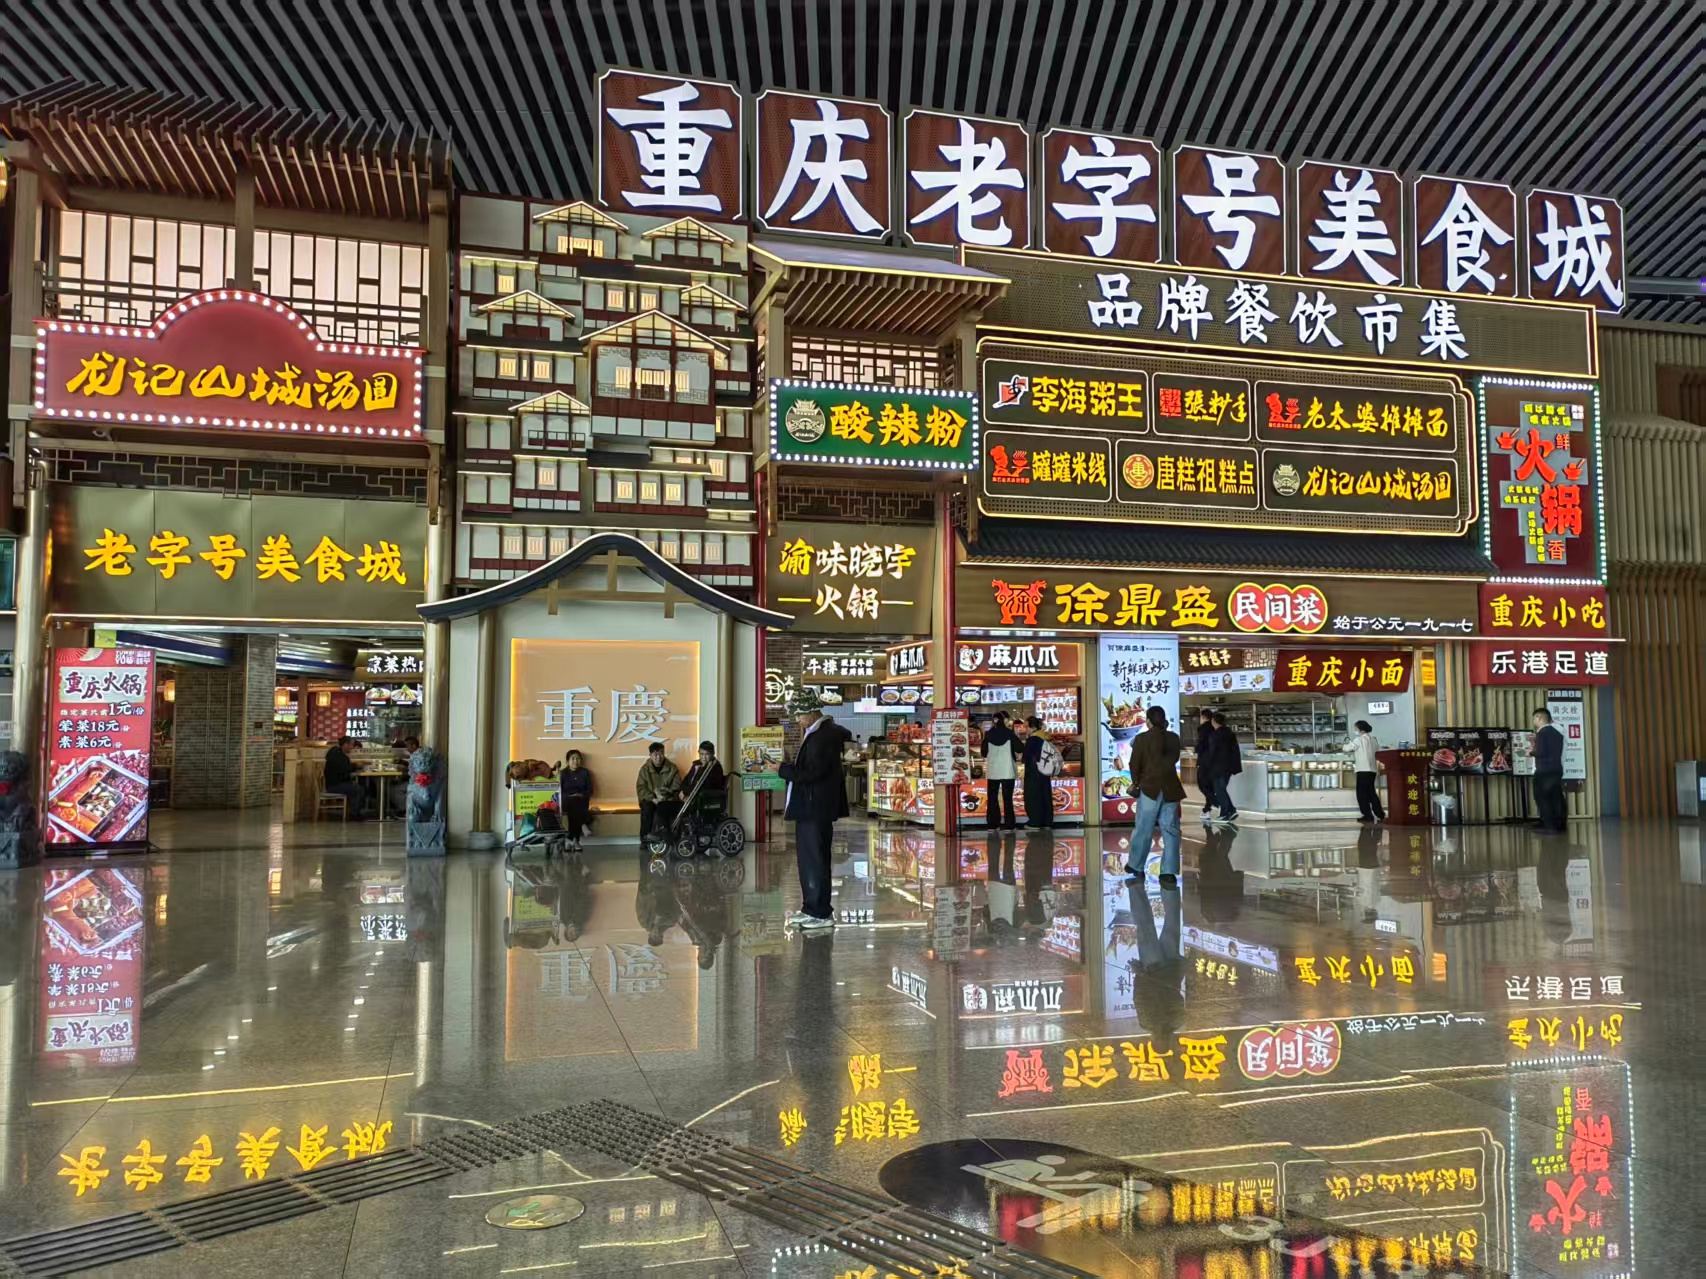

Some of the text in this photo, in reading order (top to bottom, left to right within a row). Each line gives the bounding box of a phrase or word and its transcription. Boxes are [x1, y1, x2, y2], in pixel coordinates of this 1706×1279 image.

[606, 81, 1625, 308] 重庆老字号美食城
[1088, 271, 1470, 361] 品牌餐饮市集
[65, 351, 399, 412] 龙记山城汤圆
[1031, 376, 1143, 418] 李海粥王
[829, 400, 968, 448] 酸辣粉
[1555, 432, 1570, 450] 鲜
[1031, 450, 1107, 487] 罐罐米线
[1156, 455, 1256, 495] 唐糕祖糕点
[1303, 465, 1451, 502] 龙记山城汤圆
[84, 528, 407, 585] 老字号美食城
[779, 537, 916, 580] 渝味晓宇
[1548, 540, 1565, 560] 香
[814, 583, 880, 620] 火锅
[1055, 582, 1220, 628] 徐鼎盛
[1234, 591, 1323, 626] 民间菜
[1489, 594, 1606, 629] 重庆小吃
[1333, 616, 1473, 633] 始于公元一九一七
[802, 657, 838, 676] 牛排
[988, 644, 1059, 667] 麻爪爪
[1111, 659, 1170, 681] 新鲜现炒
[1188, 648, 1231, 667] 老面包子
[1286, 655, 1404, 687] 重庆小面
[1491, 650, 1609, 676] 乐港足道
[65, 671, 142, 700] 重庆火锅
[1120, 677, 1170, 695] 味道更好
[536, 684, 670, 744] 重慶
[1552, 705, 1578, 715] 消火栓
[1407, 774, 1420, 816] 欢迎您
